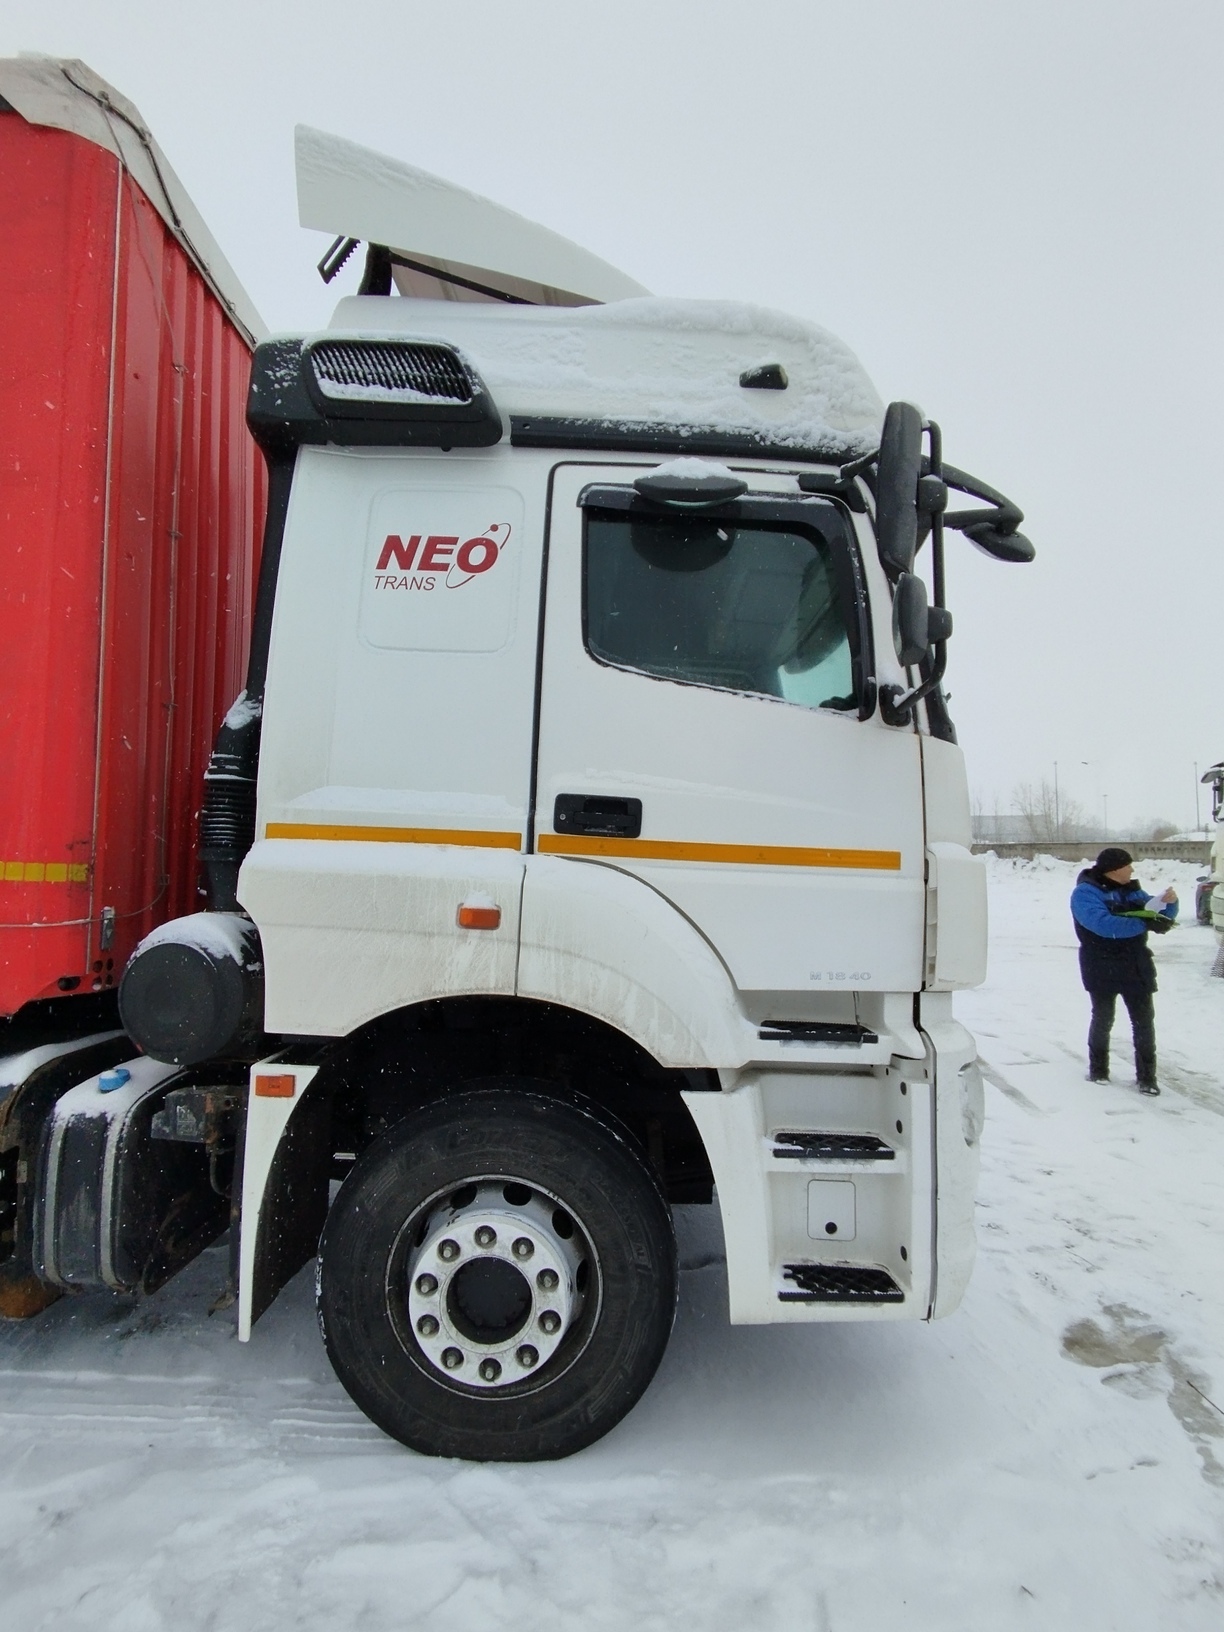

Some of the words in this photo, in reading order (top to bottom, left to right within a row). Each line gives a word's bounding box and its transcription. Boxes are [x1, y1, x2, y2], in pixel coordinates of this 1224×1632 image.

[375, 535, 499, 574] NEO
[374, 575, 436, 591] TRANS
[809, 971, 822, 981] M
